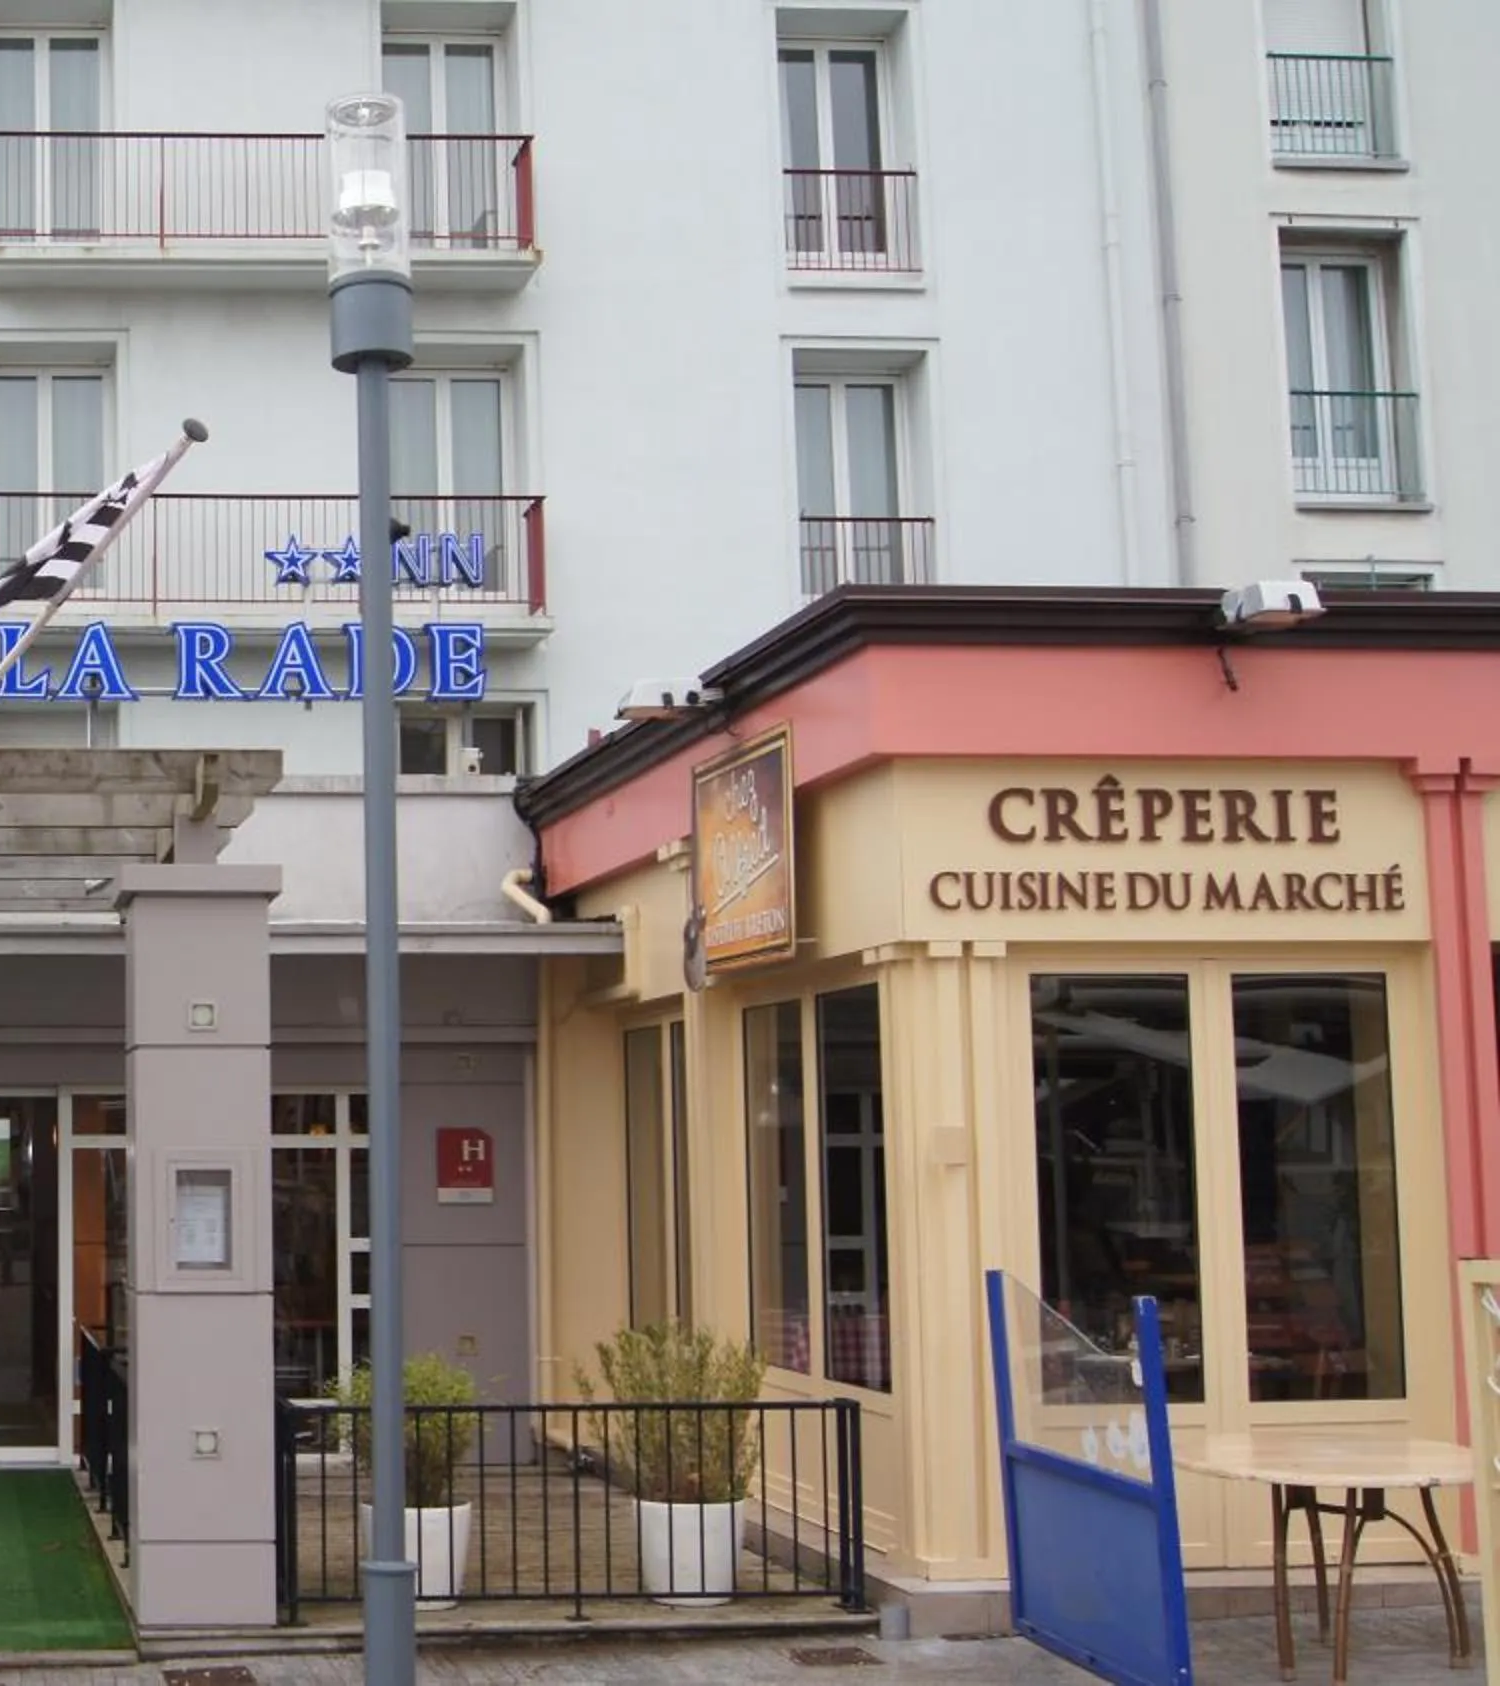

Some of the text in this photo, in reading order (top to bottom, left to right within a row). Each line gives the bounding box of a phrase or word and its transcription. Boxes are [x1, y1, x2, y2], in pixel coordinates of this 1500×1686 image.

[171, 621, 486, 701] RADE
[987, 773, 1341, 844] CRÊPERIE
[928, 863, 1405, 912] CUISINE DU MARCHÉ
[462, 1138, 485, 1161] H
